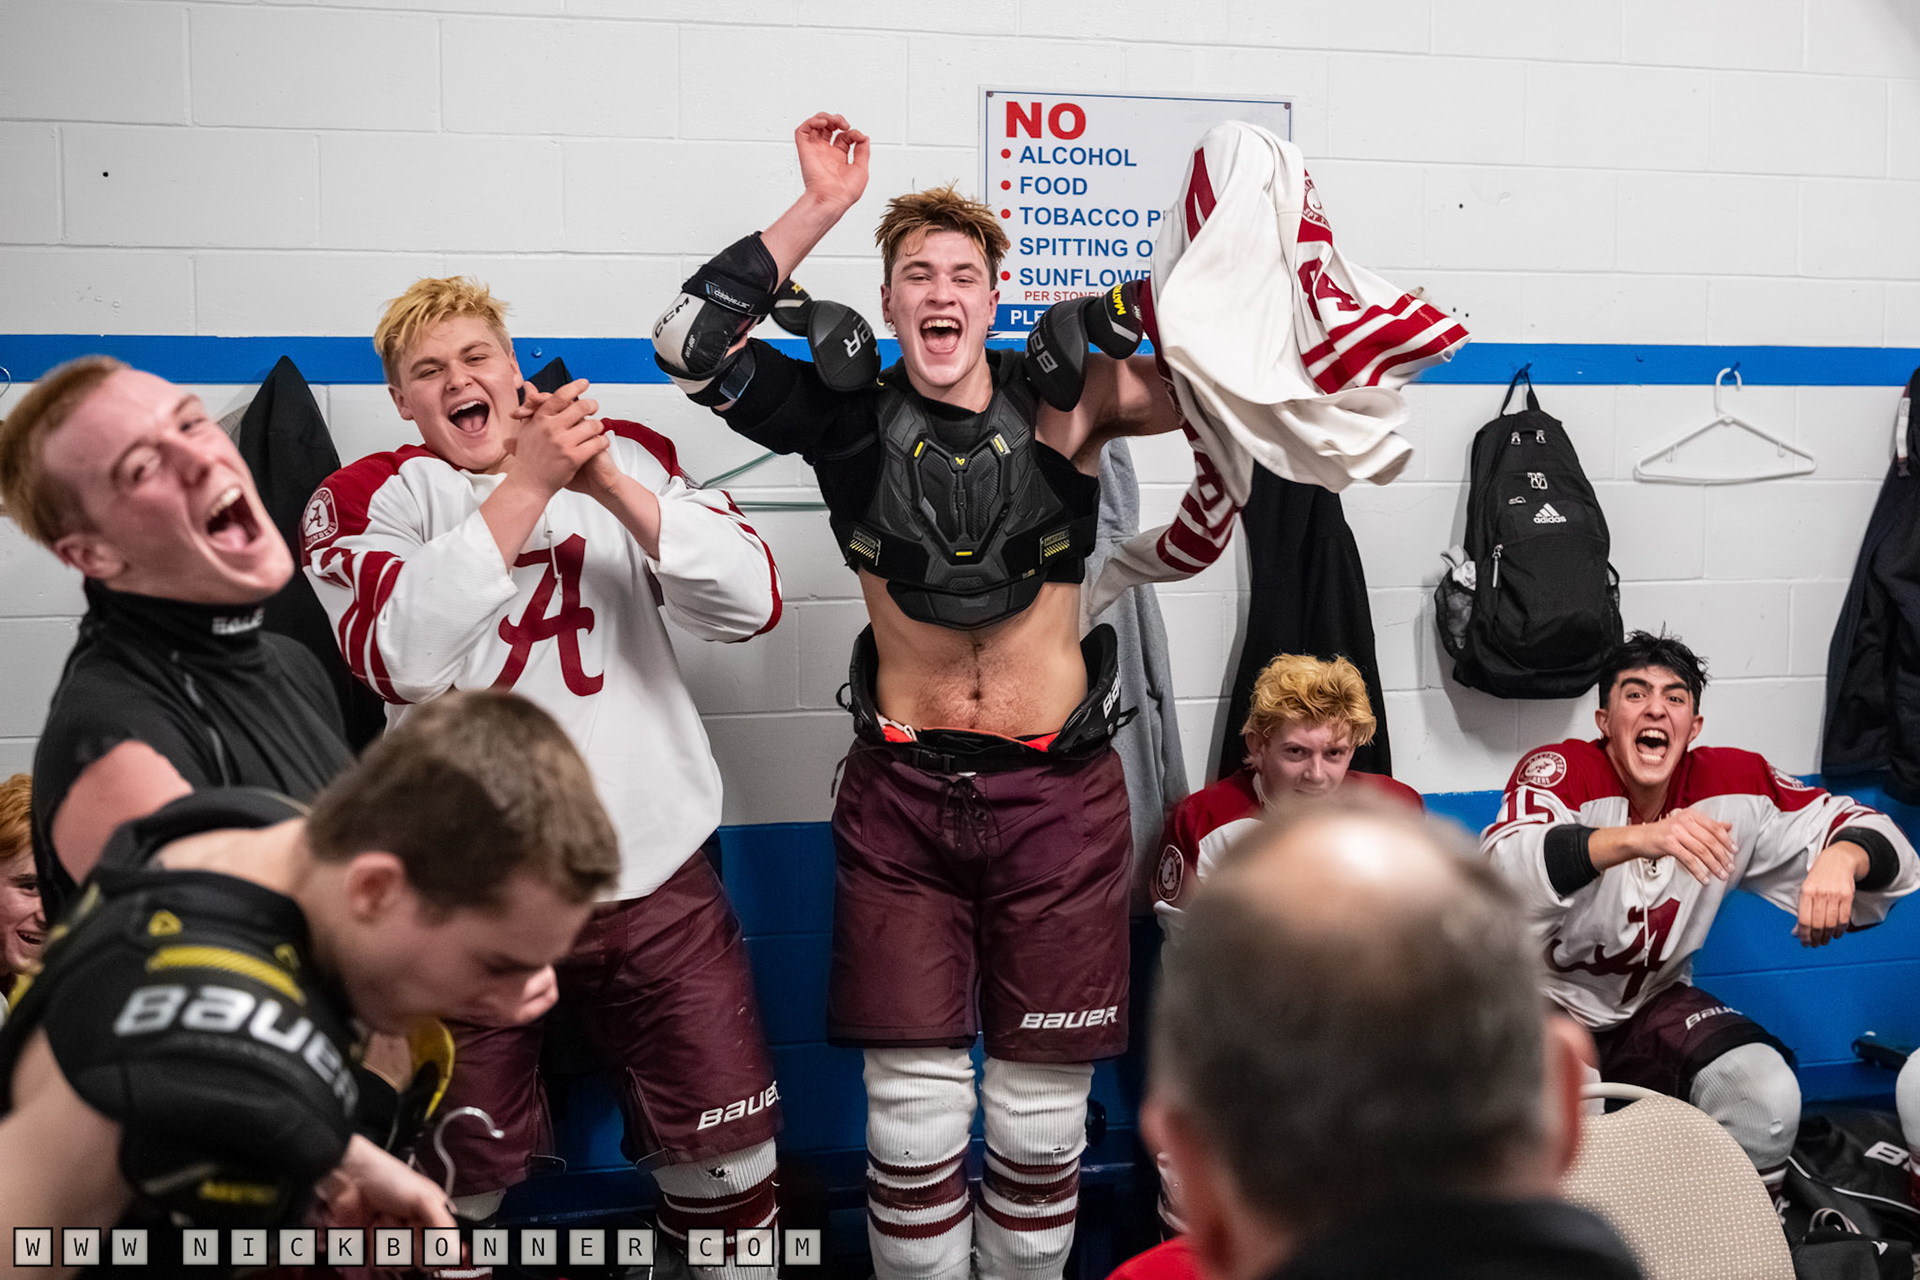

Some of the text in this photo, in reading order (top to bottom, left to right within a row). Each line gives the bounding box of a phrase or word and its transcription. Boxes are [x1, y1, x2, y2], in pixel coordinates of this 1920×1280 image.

[1005, 101, 1087, 140] NO
[1019, 146, 1138, 166] ALCOHOL
[1019, 176, 1088, 195] FOOD
[1019, 207, 1162, 228] TOBACCO P
[1019, 237, 1154, 258] SPITTING O
[1025, 291, 1050, 301] PER
[655, 297, 689, 339] CCM
[1533, 515, 1567, 524] adidas
[1020, 1005, 1118, 1030] BAUER
[697, 1080, 782, 1131] BAUE
